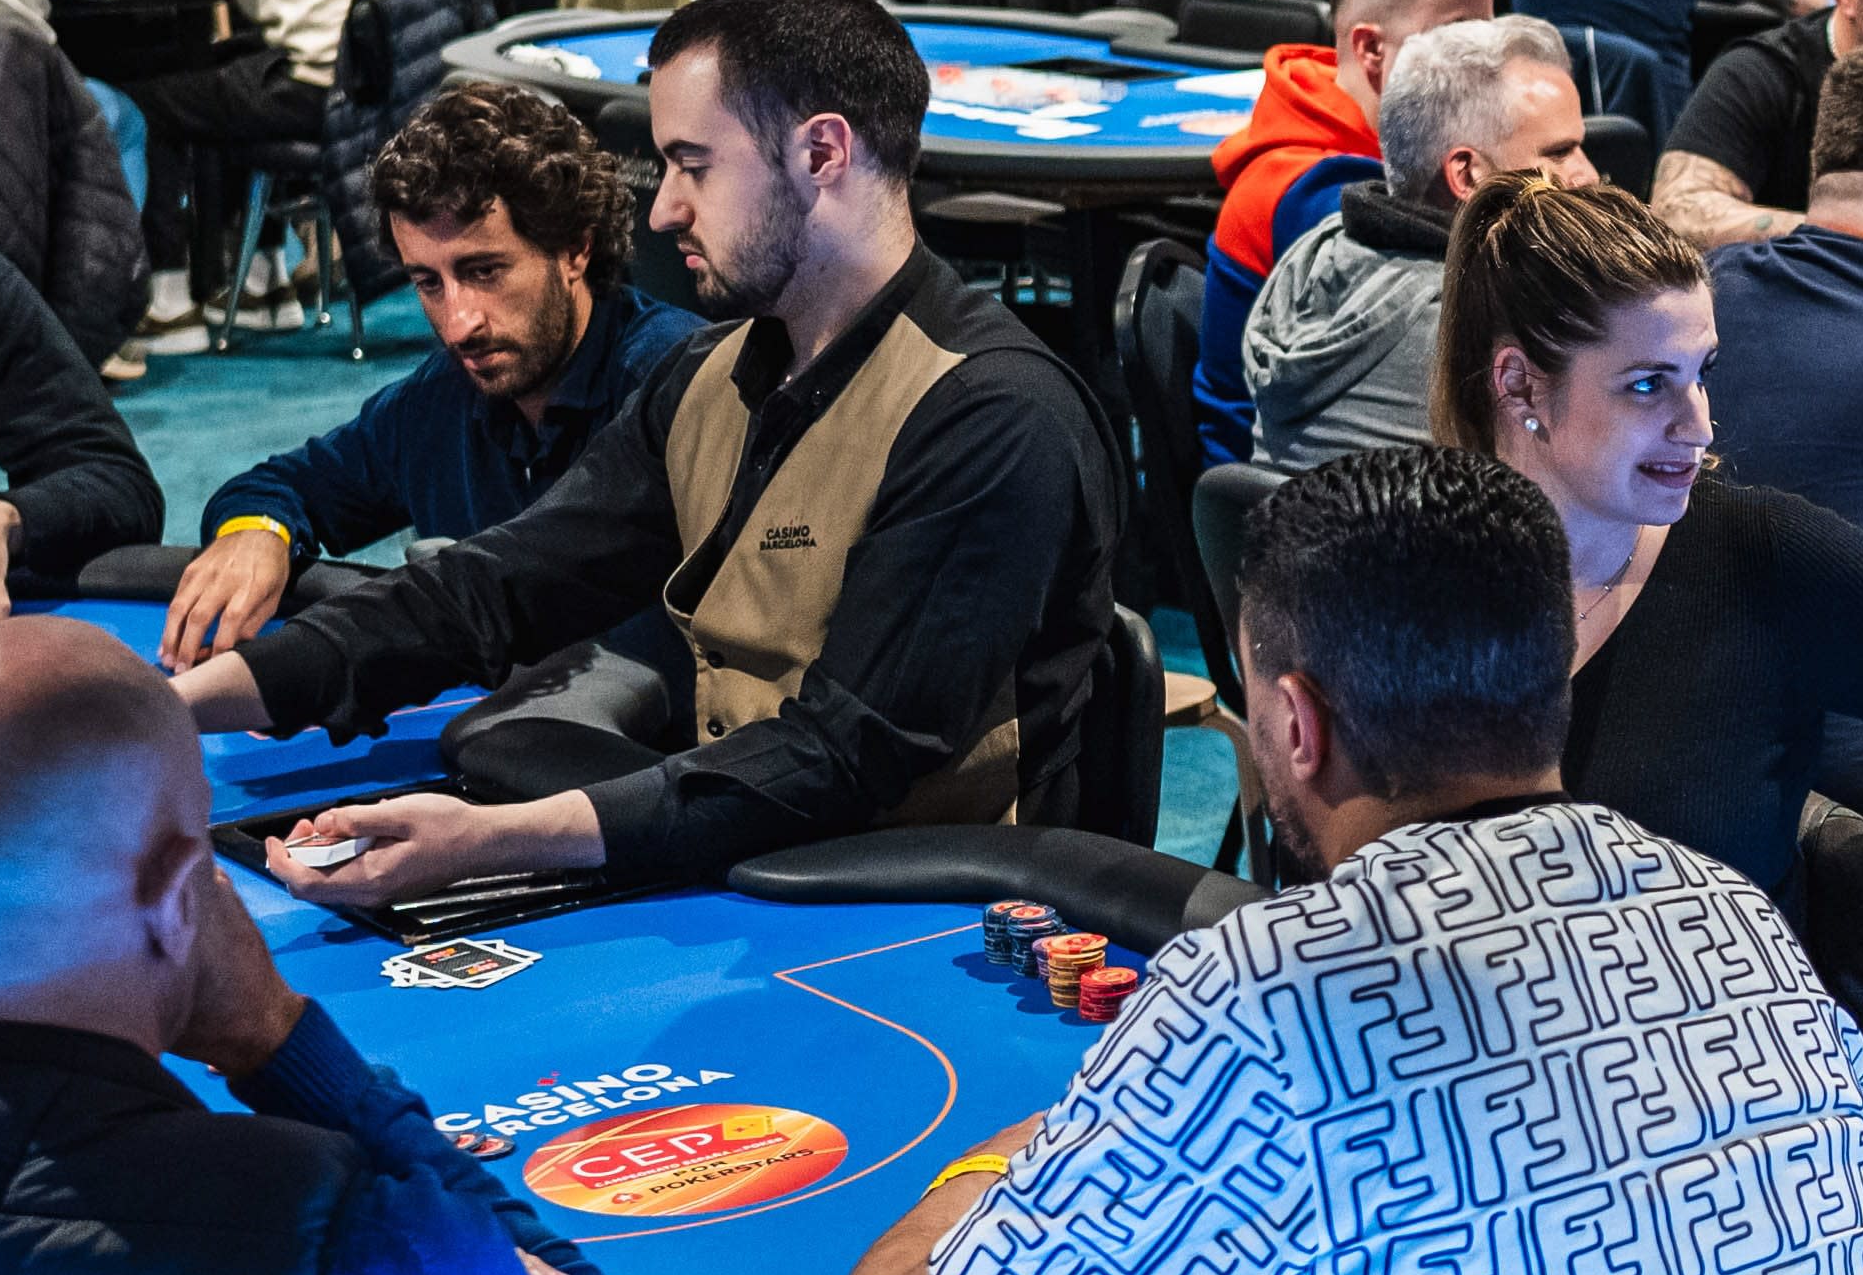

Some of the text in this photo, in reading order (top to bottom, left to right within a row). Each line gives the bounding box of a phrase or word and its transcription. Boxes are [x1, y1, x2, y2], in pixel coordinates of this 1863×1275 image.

[759, 537, 818, 551] BARCELONA
[766, 524, 811, 540] CASINO
[433, 1063, 672, 1132] CASINO
[489, 1068, 736, 1137] RCELONA
[571, 1132, 714, 1178] CEP
[648, 1148, 815, 1194] POKERSTARS
[672, 1159, 728, 1178] POR
